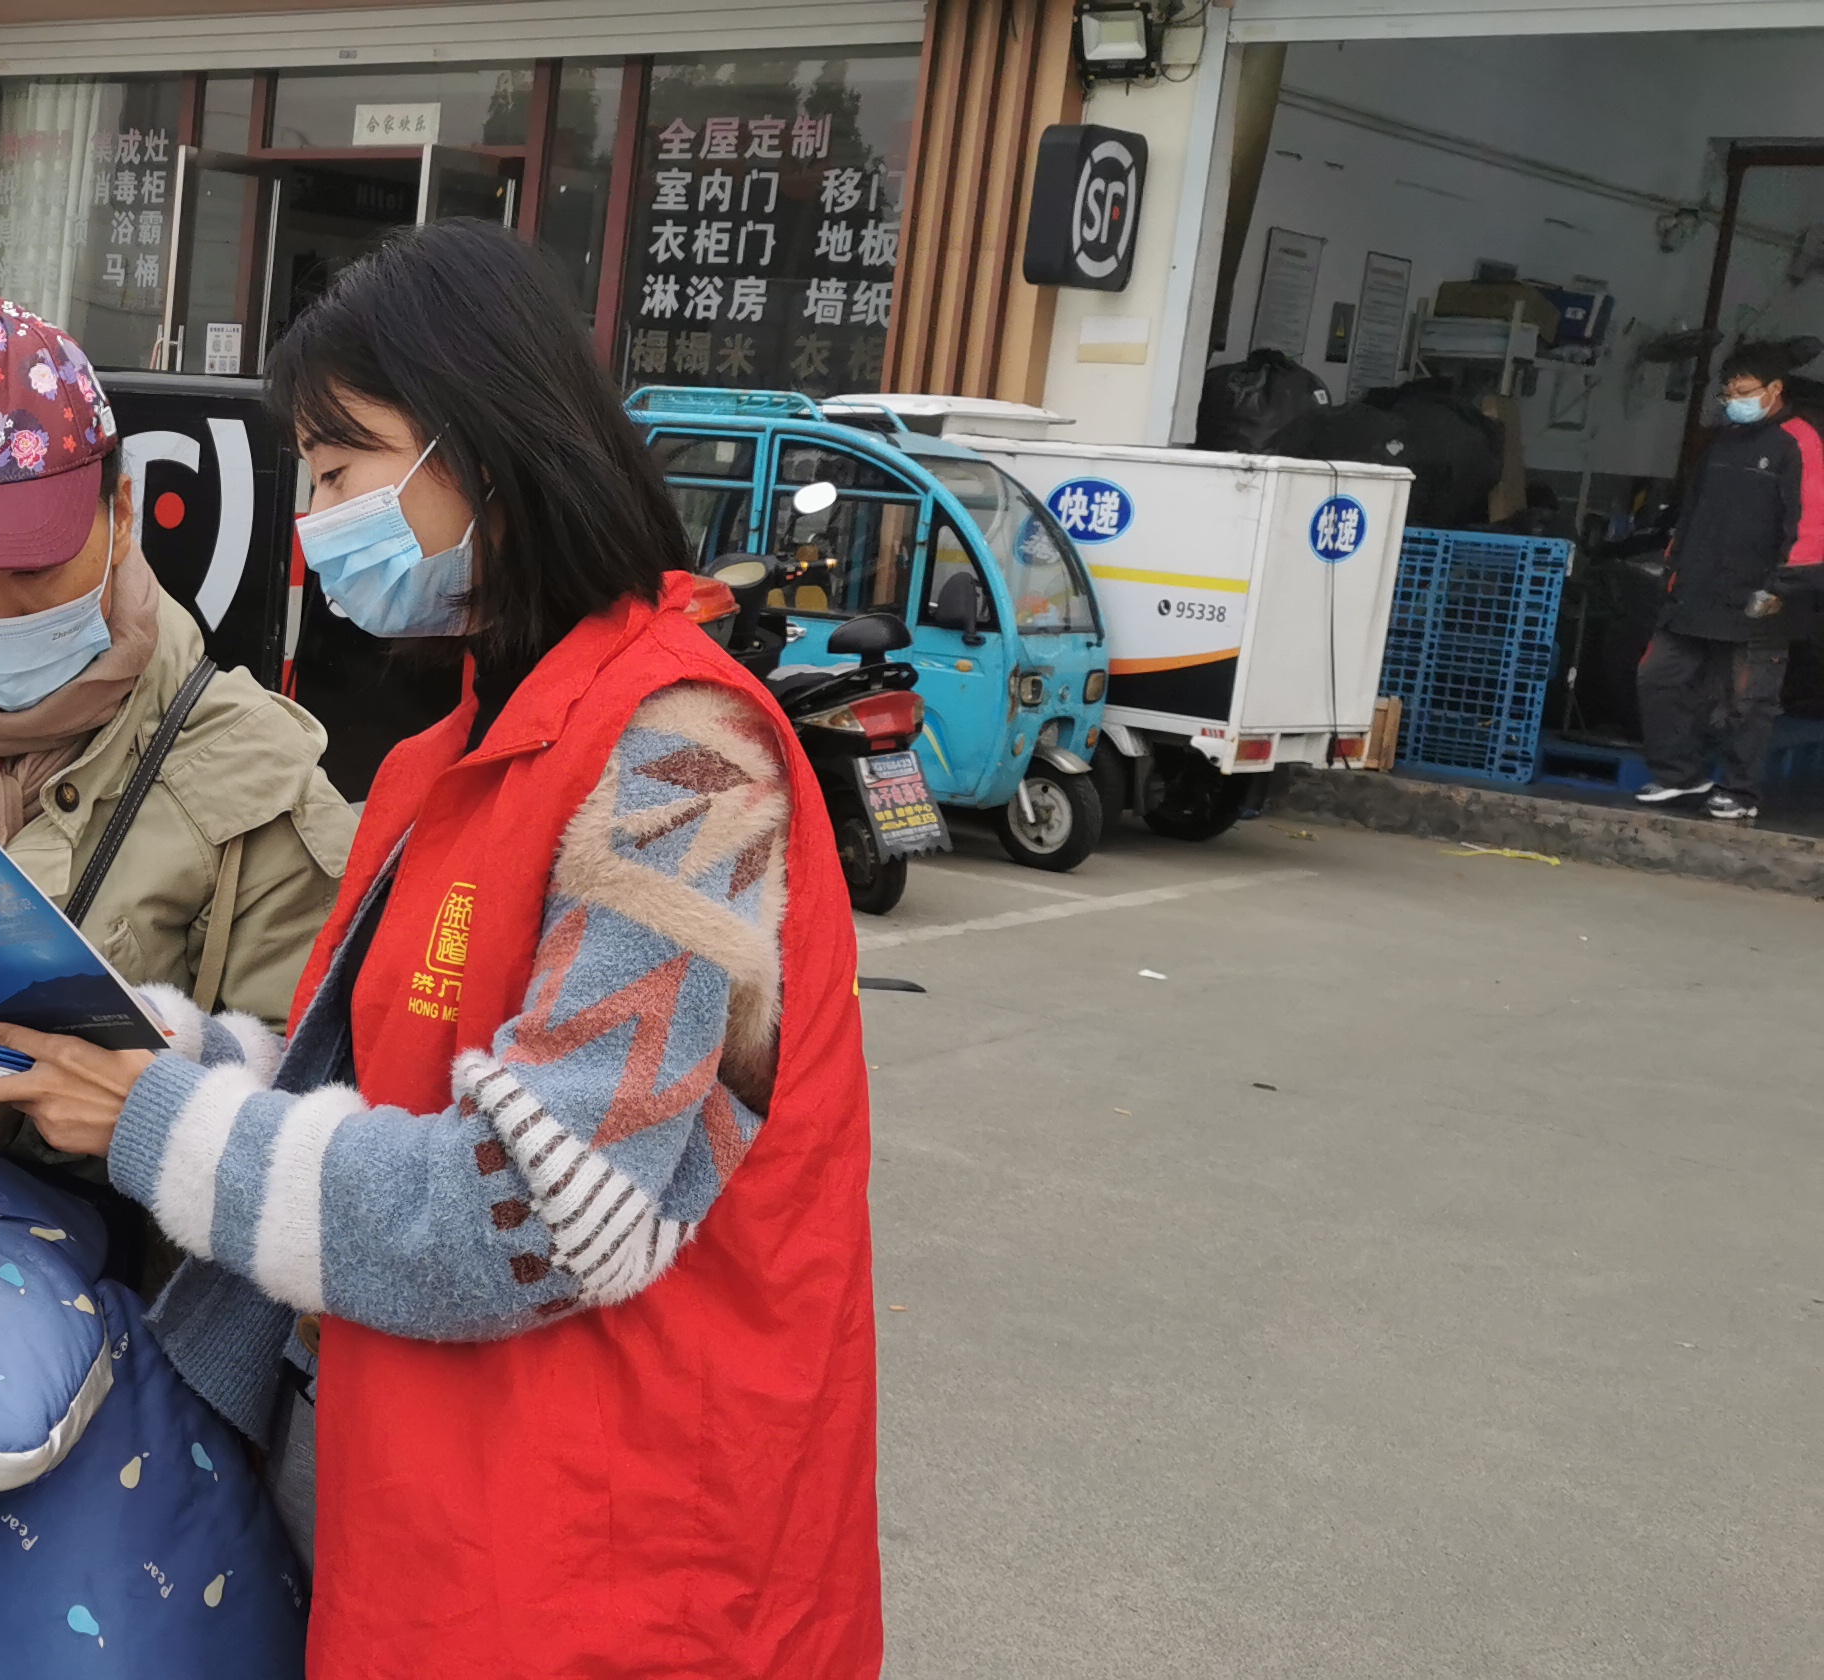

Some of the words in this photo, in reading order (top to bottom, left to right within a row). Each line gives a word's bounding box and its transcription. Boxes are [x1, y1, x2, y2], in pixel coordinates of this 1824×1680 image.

[366, 114, 427, 134] 合家欢乐
[658, 113, 831, 160] 全屋定制
[91, 128, 169, 164] 集成灶
[88, 170, 167, 205] 消毒柜
[652, 168, 780, 213] 室内门
[820, 165, 906, 214] 移门
[111, 210, 163, 245] 浴霸
[648, 220, 776, 266] 衣柜门
[814, 220, 899, 267] 地板
[103, 253, 160, 288] 马桶
[640, 274, 768, 322] 淋浴房
[803, 277, 893, 328] 墙纸
[1056, 489, 1130, 536] 快递
[1315, 505, 1362, 555] 快递
[1175, 600, 1227, 623] 95338
[412, 972, 462, 1002] 洪门
[408, 997, 438, 1018] HONG
[442, 1007, 459, 1022] ME
[1, 1512, 39, 1551] Pear
[143, 1560, 174, 1599] Pear
